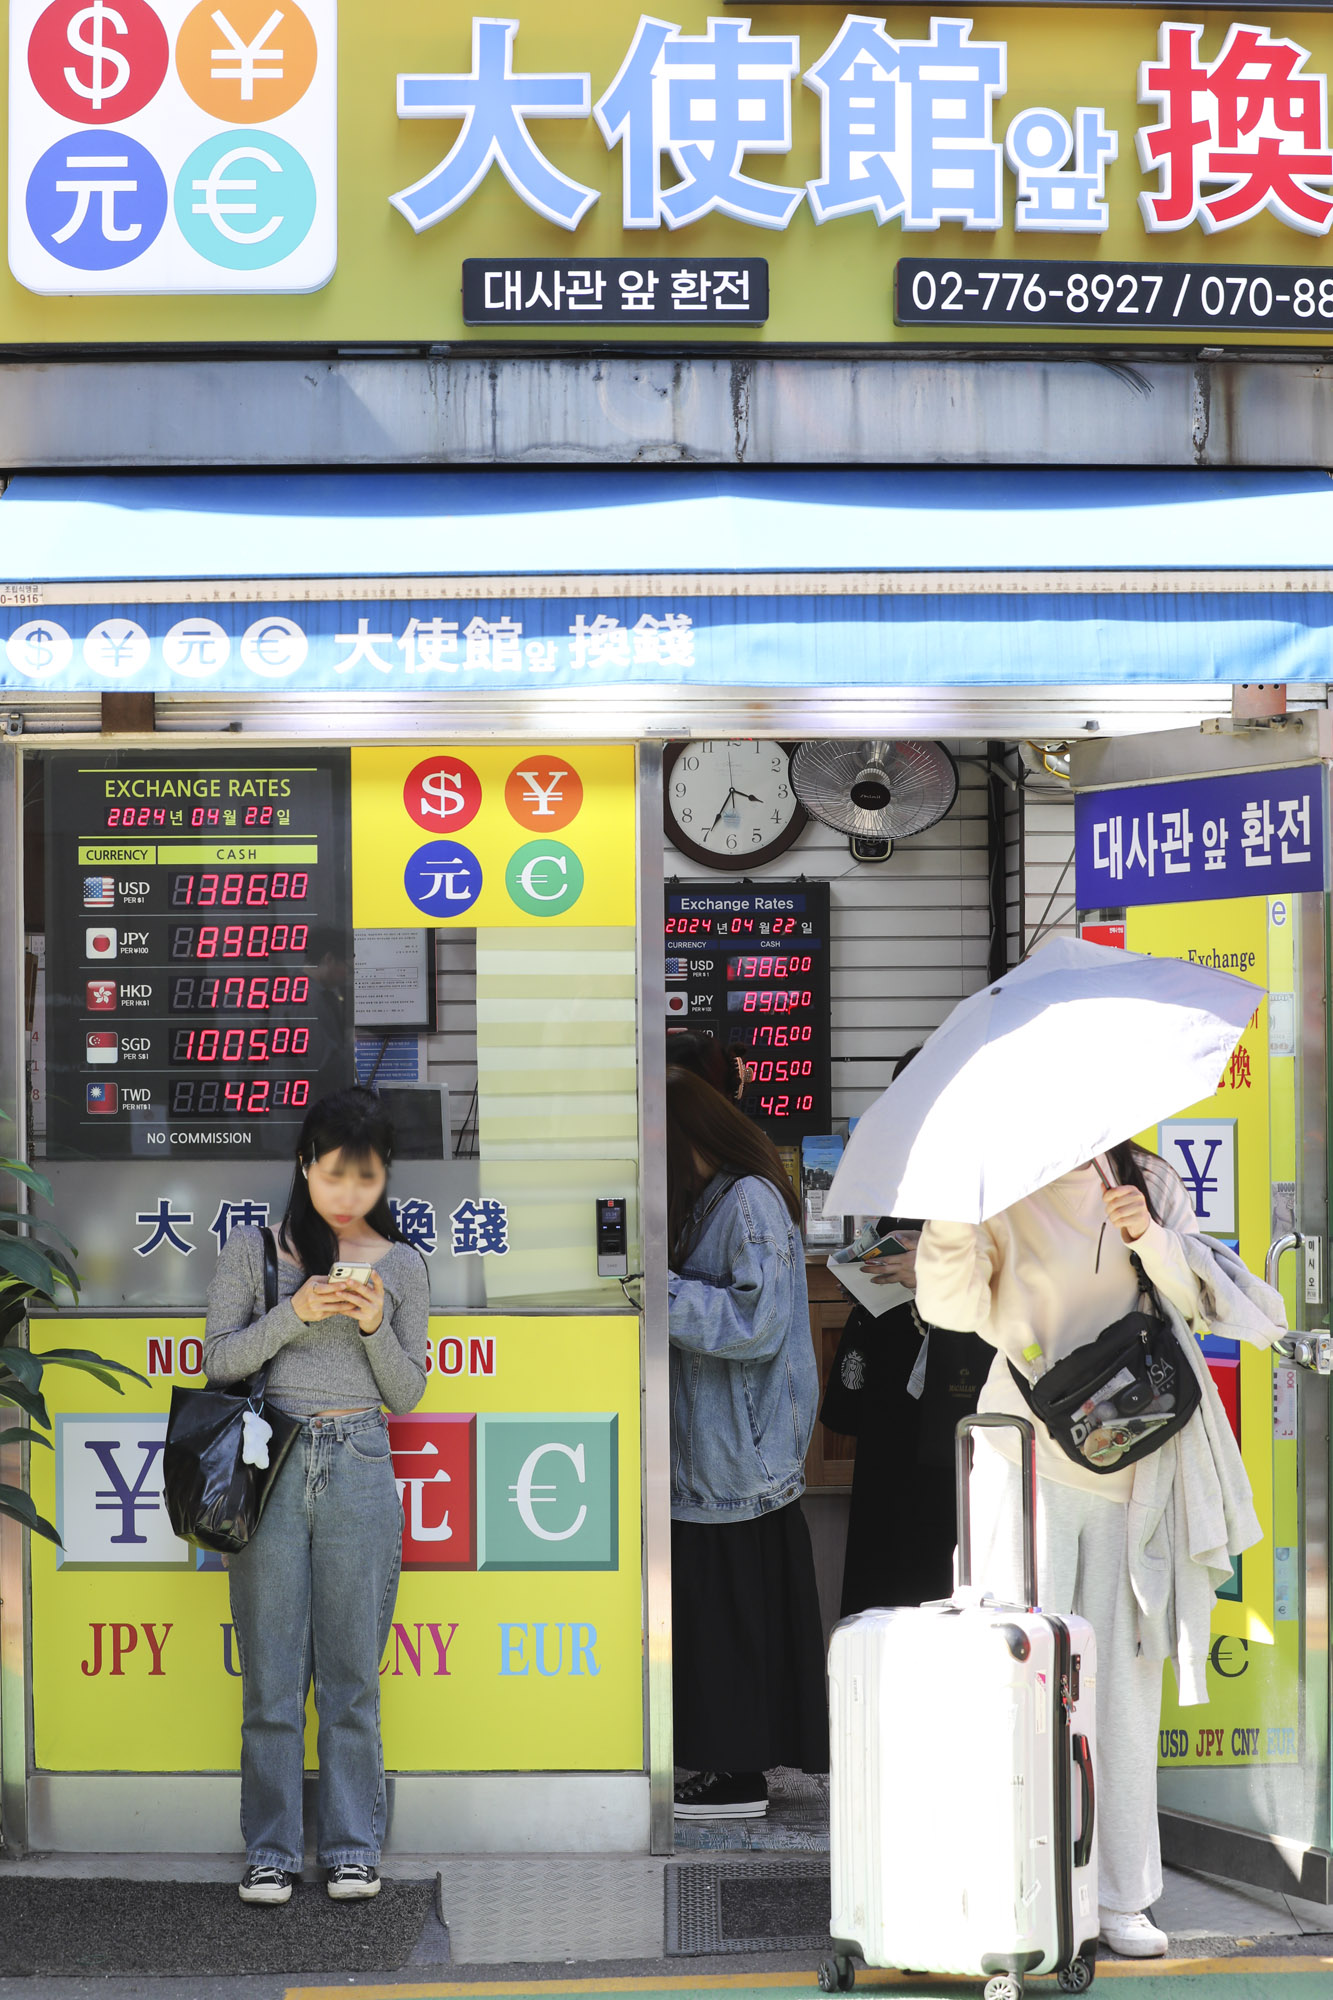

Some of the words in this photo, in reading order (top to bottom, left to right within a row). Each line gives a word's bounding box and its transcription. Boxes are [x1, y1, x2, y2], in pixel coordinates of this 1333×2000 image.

[52, 156, 142, 244] 元
[484, 270, 606, 311] 대사관
[619, 270, 661, 312] 앞
[670, 269, 751, 311] 환전
[567, 613, 697, 669] 換錢
[105, 779, 221, 798] EXCHANGE
[228, 778, 292, 798] RATES
[1093, 807, 1194, 880] 대사관
[1202, 817, 1229, 871] 앞
[1240, 795, 1311, 867] 환전
[86, 849, 149, 861] CURRENCY
[216, 848, 257, 860] CASH
[419, 857, 472, 901] 元
[118, 881, 151, 896] USD
[681, 897, 750, 911] Exchange
[754, 897, 794, 910] Rates
[119, 932, 150, 947] JPY
[667, 941, 707, 949] CURRENCY
[690, 960, 714, 971] USD
[119, 984, 152, 998] HKD
[690, 995, 714, 1006] JPY
[121, 1037, 151, 1051] SGD
[121, 1088, 151, 1102] TWD
[147, 1132, 166, 1144] NO
[169, 1132, 252, 1145] COMMISSION
[81, 1622, 173, 1677] JPY
[379, 1622, 460, 1677] NY
[497, 1622, 602, 1677] EUR
[1160, 1729, 1189, 1758] USD
[1195, 1728, 1225, 1757] JPY
[1231, 1727, 1260, 1757] CNY
[1266, 1727, 1297, 1757] EUR
